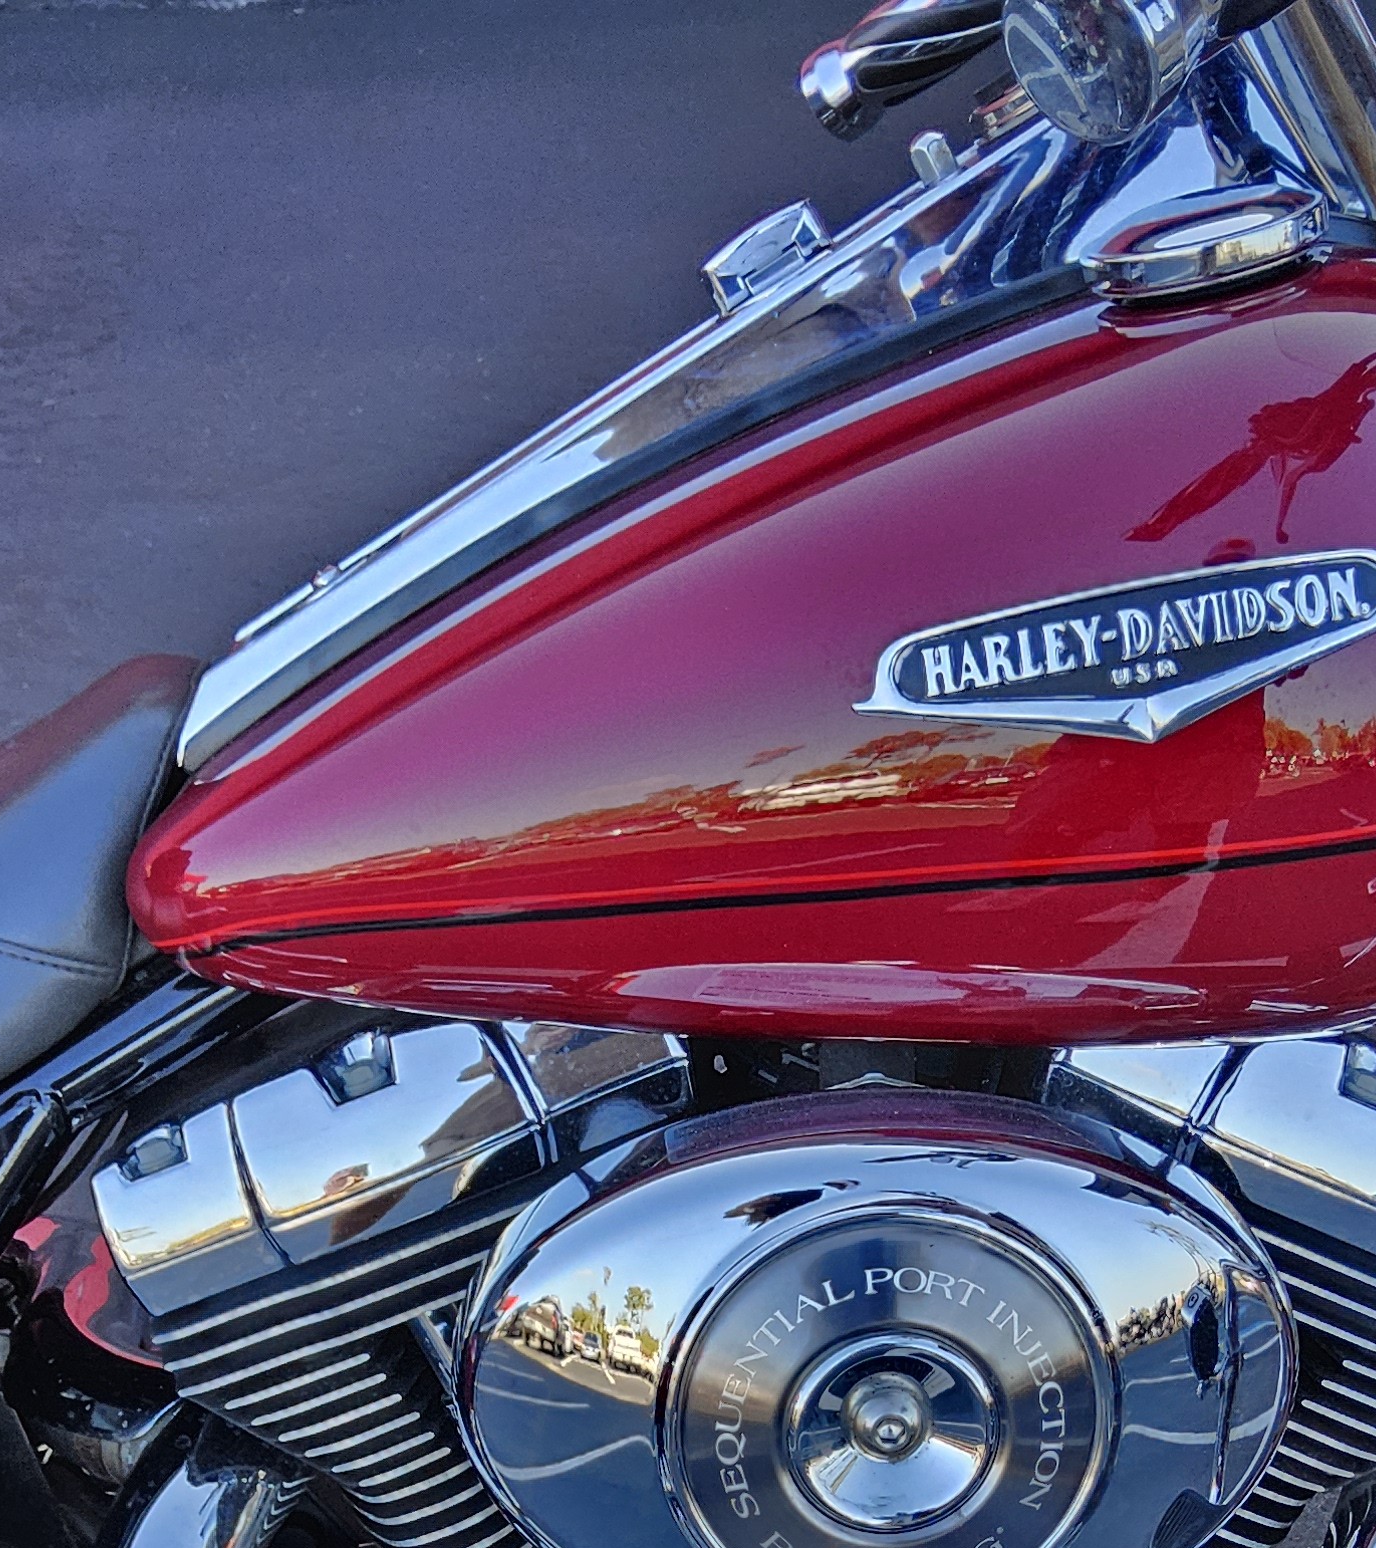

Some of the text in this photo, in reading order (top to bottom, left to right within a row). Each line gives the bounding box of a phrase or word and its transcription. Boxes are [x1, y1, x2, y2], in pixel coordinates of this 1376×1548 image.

[920, 567, 1361, 697] HARLEY-DAVIDSON
[1110, 659, 1178, 688] USA
[714, 1266, 1065, 1520] SEQUENTIAL PORT INJECTION
